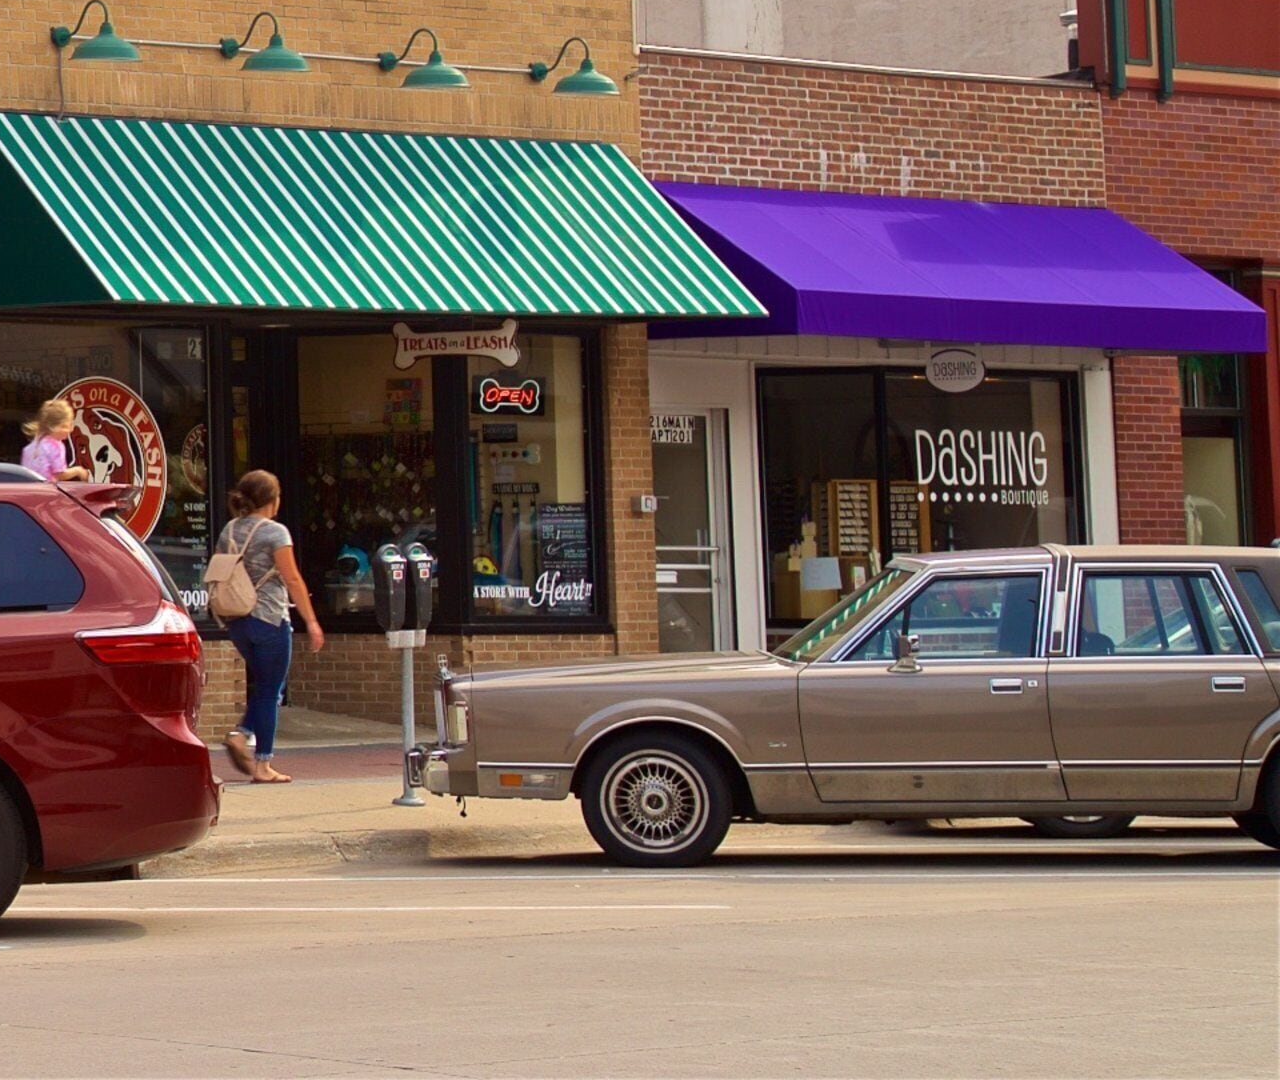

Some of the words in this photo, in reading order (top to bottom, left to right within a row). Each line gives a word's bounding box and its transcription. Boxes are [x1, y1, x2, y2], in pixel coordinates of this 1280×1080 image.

[401, 337, 447, 352] TREATS
[448, 341, 458, 349] on
[466, 336, 508, 350] LEASH
[485, 387, 533, 405] OPEN
[89, 388, 108, 403] on
[110, 393, 121, 405] a
[123, 398, 162, 488] LEASH
[473, 585, 479, 598] A
[480, 585, 506, 598] STORE
[508, 586, 530, 598] WITH
